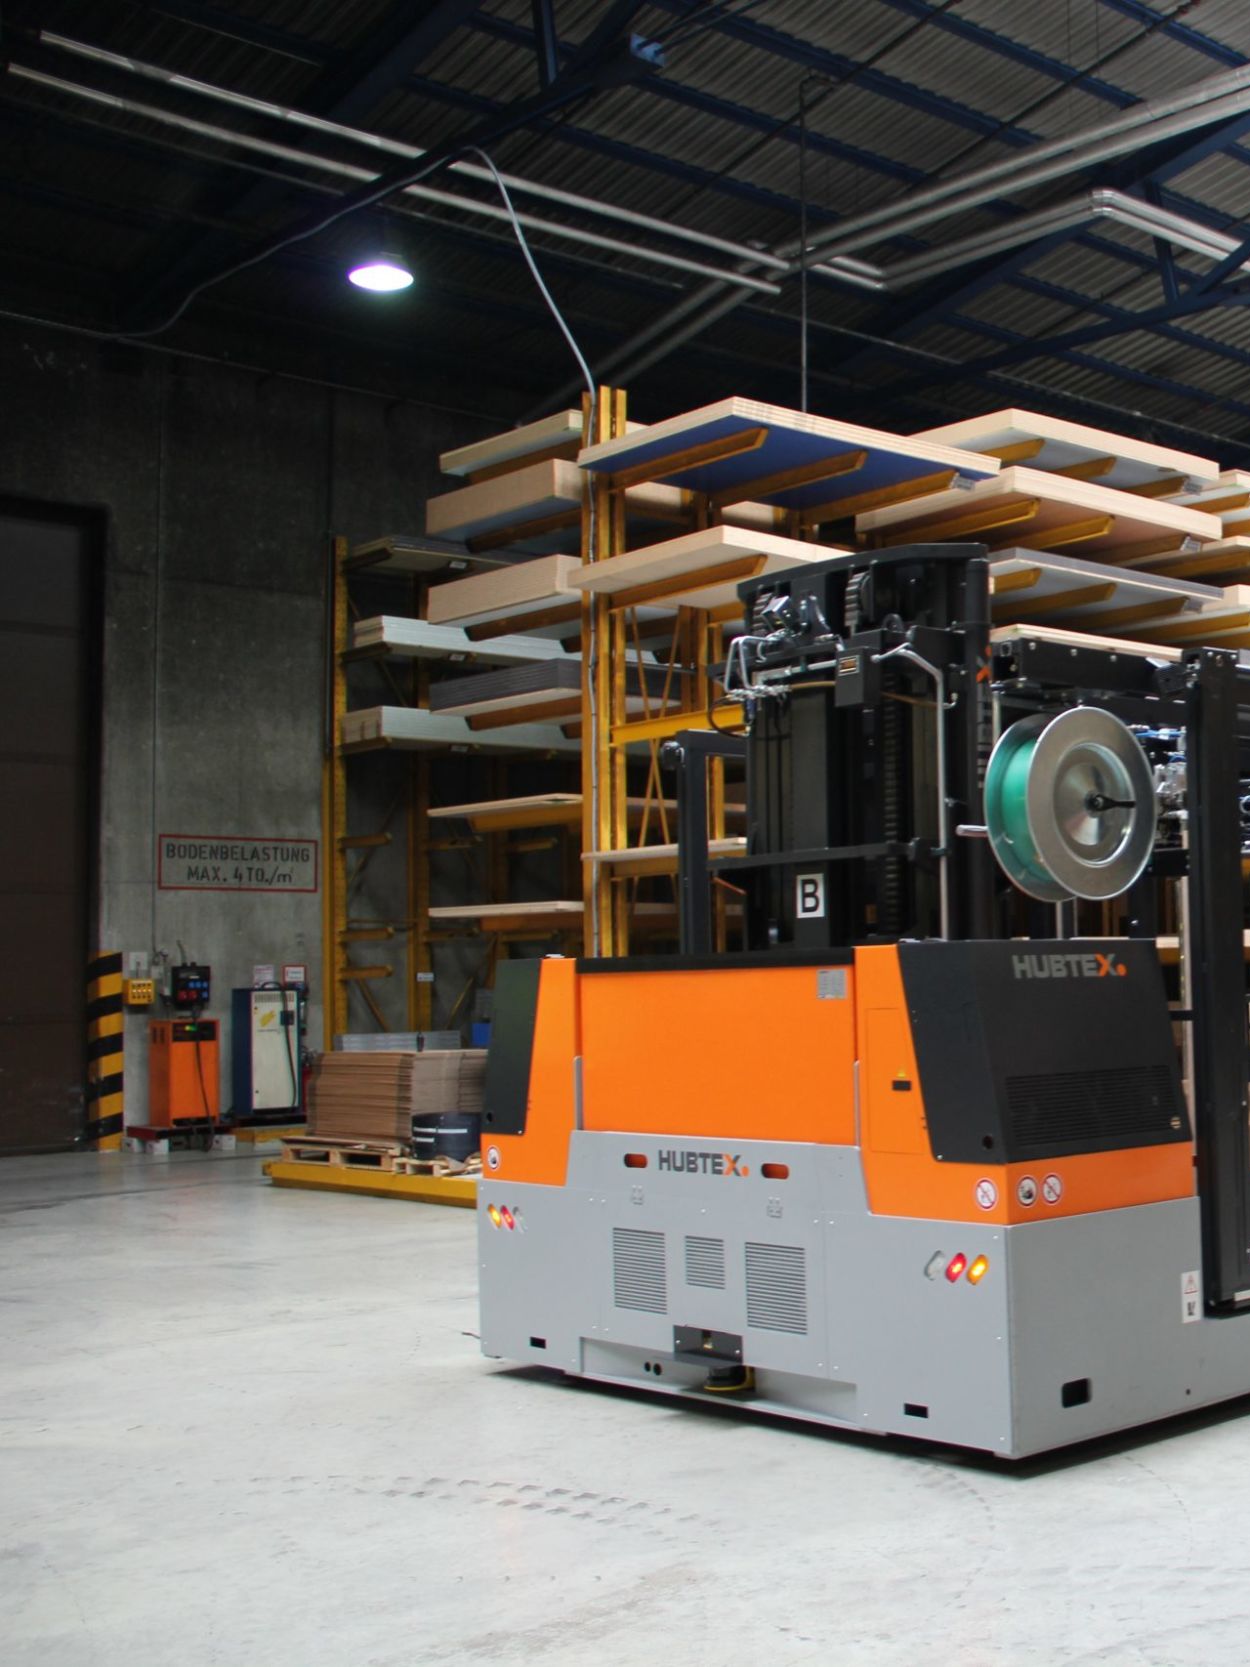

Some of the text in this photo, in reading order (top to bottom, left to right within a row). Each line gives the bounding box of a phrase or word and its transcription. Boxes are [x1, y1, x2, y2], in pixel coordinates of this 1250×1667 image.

[166, 843, 310, 863] BODENBELASTUNG
[187, 865, 227, 882] MAX.
[801, 878, 820, 913] B
